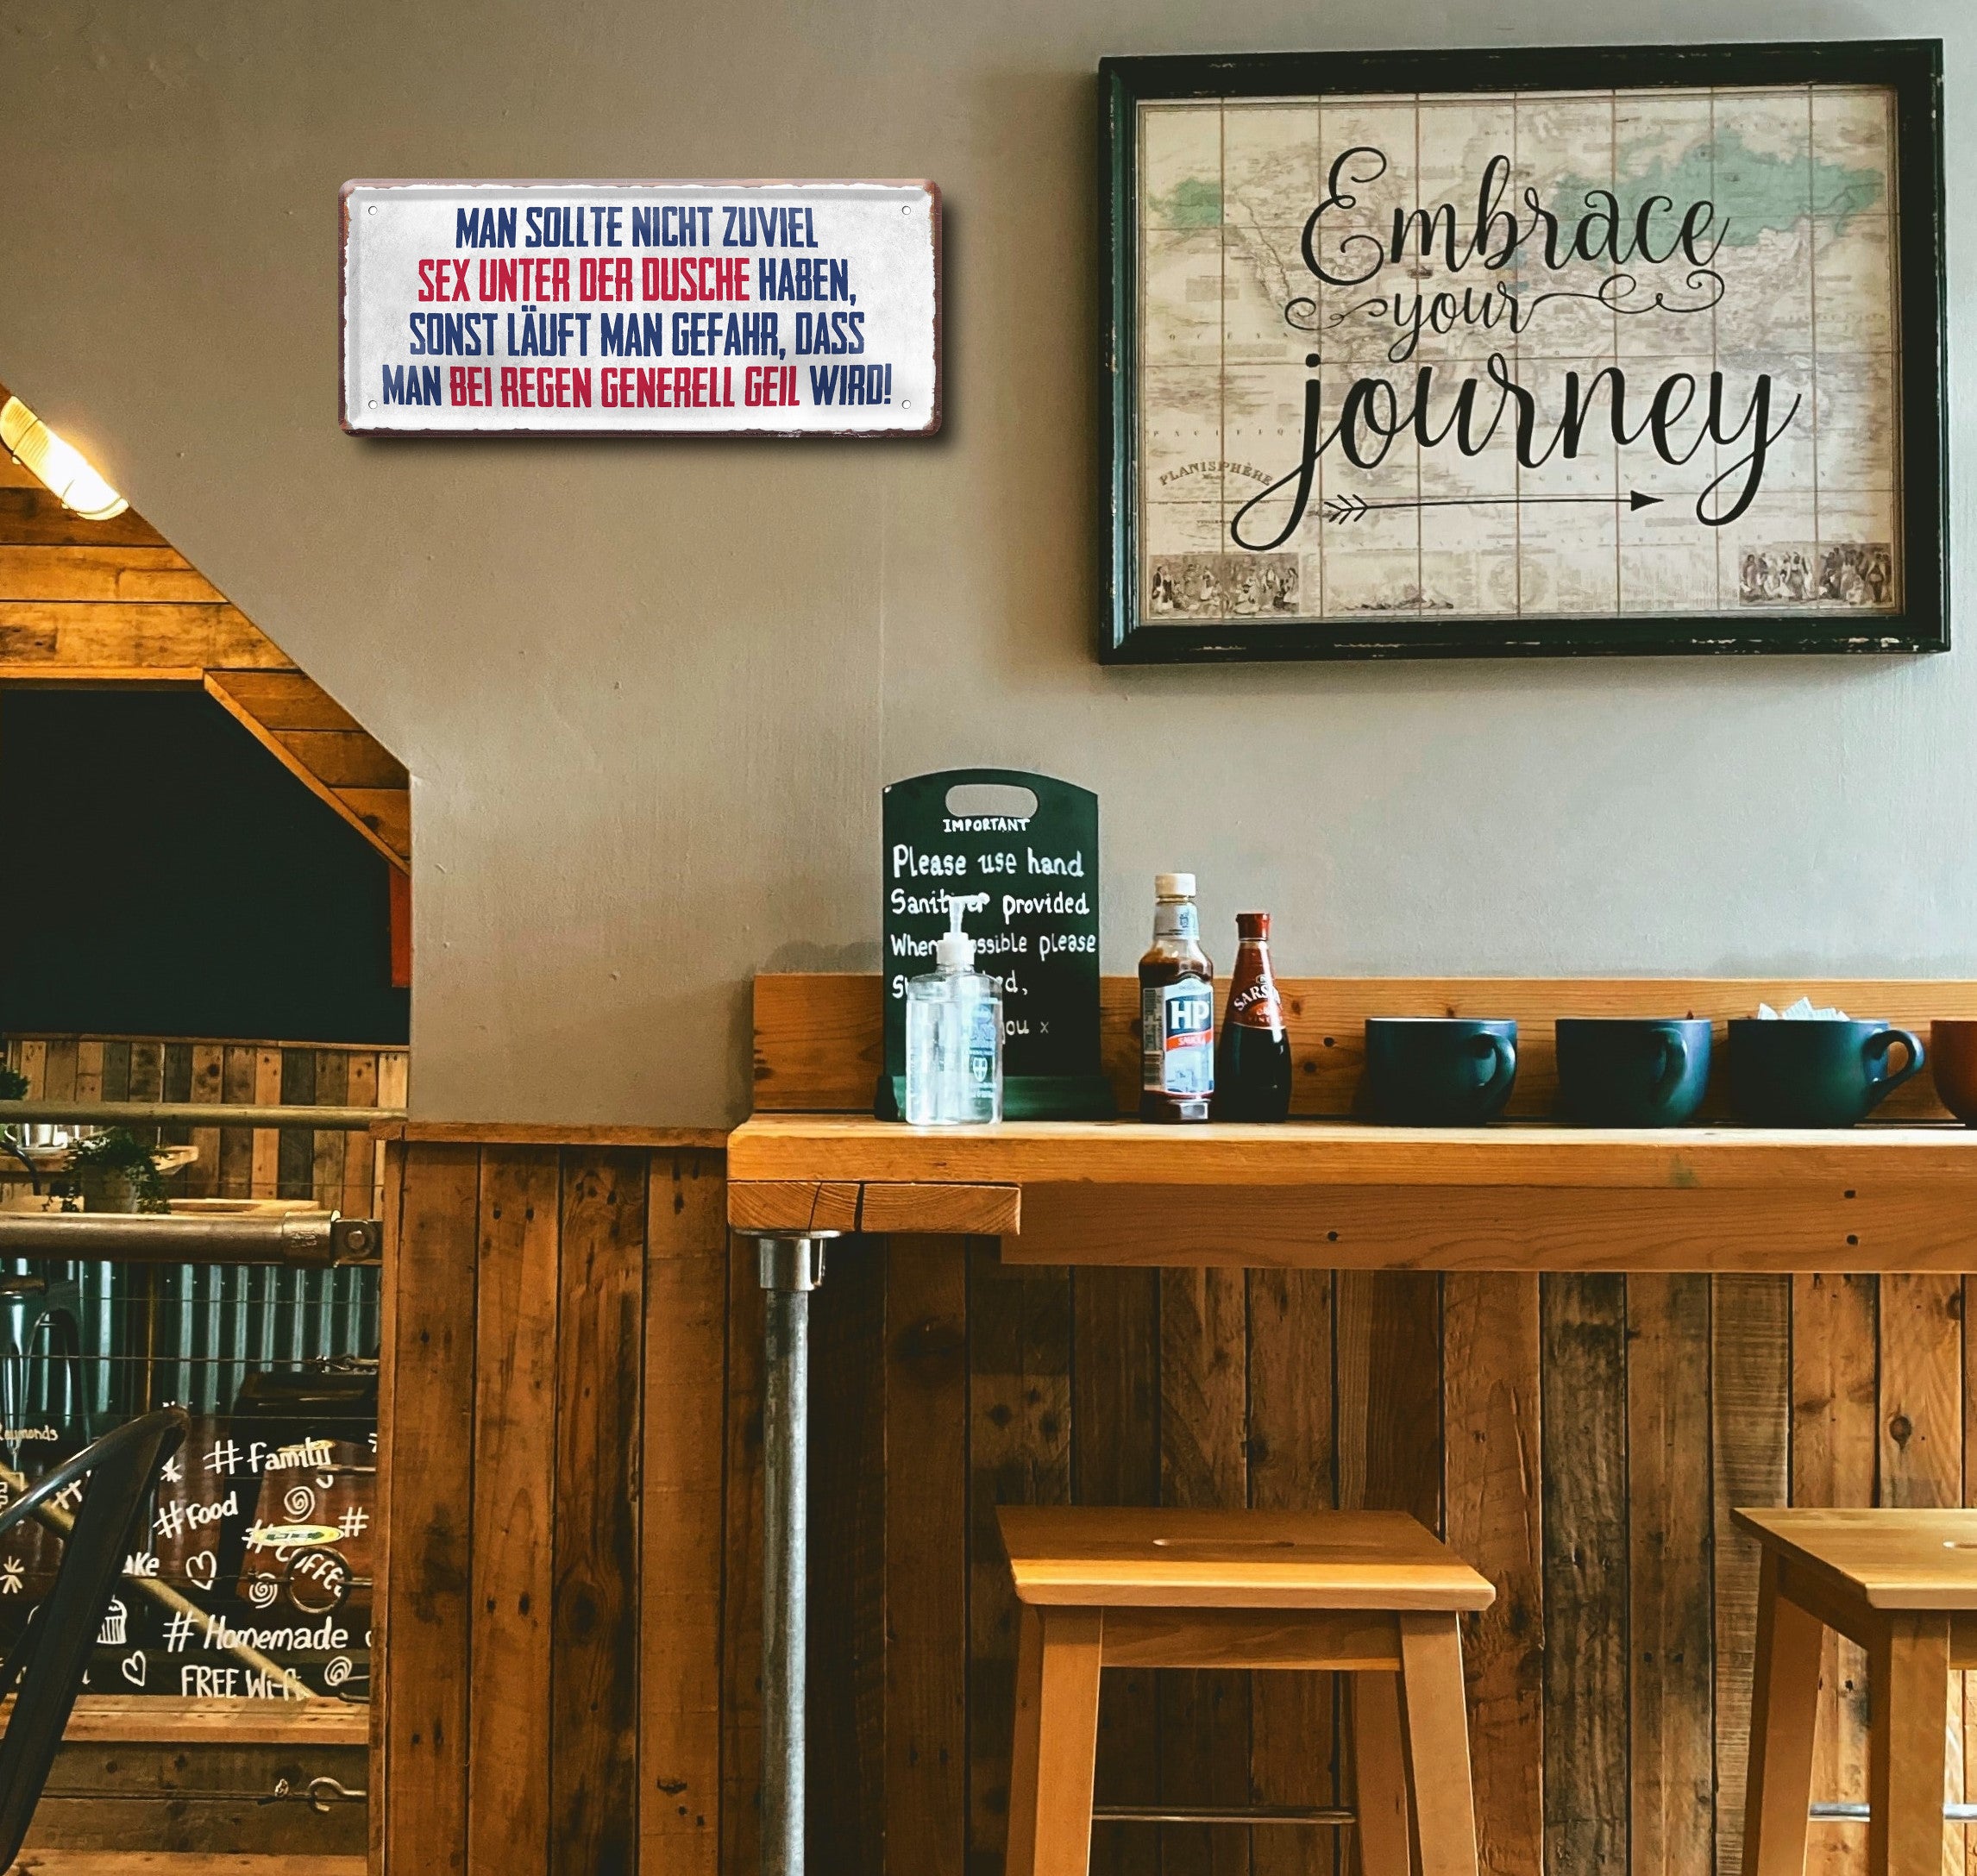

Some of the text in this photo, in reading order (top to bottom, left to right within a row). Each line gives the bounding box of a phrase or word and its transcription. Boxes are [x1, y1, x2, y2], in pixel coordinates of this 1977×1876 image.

[456, 206, 819, 248] MAN SOLLTE NICHT ZUVIEL
[1301, 147, 1729, 285] Embrace
[418, 257, 857, 305] SEX UNTER DER DUSCHE HABEN,
[410, 304, 865, 359] SONST LÄUFT MAN GEFAHR, DASS
[382, 364, 891, 408] MAN BEI REGEN GENERELL GEIL WIRD!
[1231, 352, 1803, 550] journey
[942, 818, 1031, 832] IMPORTANT
[893, 844, 1084, 878] Please use hand
[1002, 890, 1090, 925] provided
[1039, 933, 1096, 963] please
[1171, 1001, 1209, 1029] HP
[181, 1665, 239, 1699] FREE
